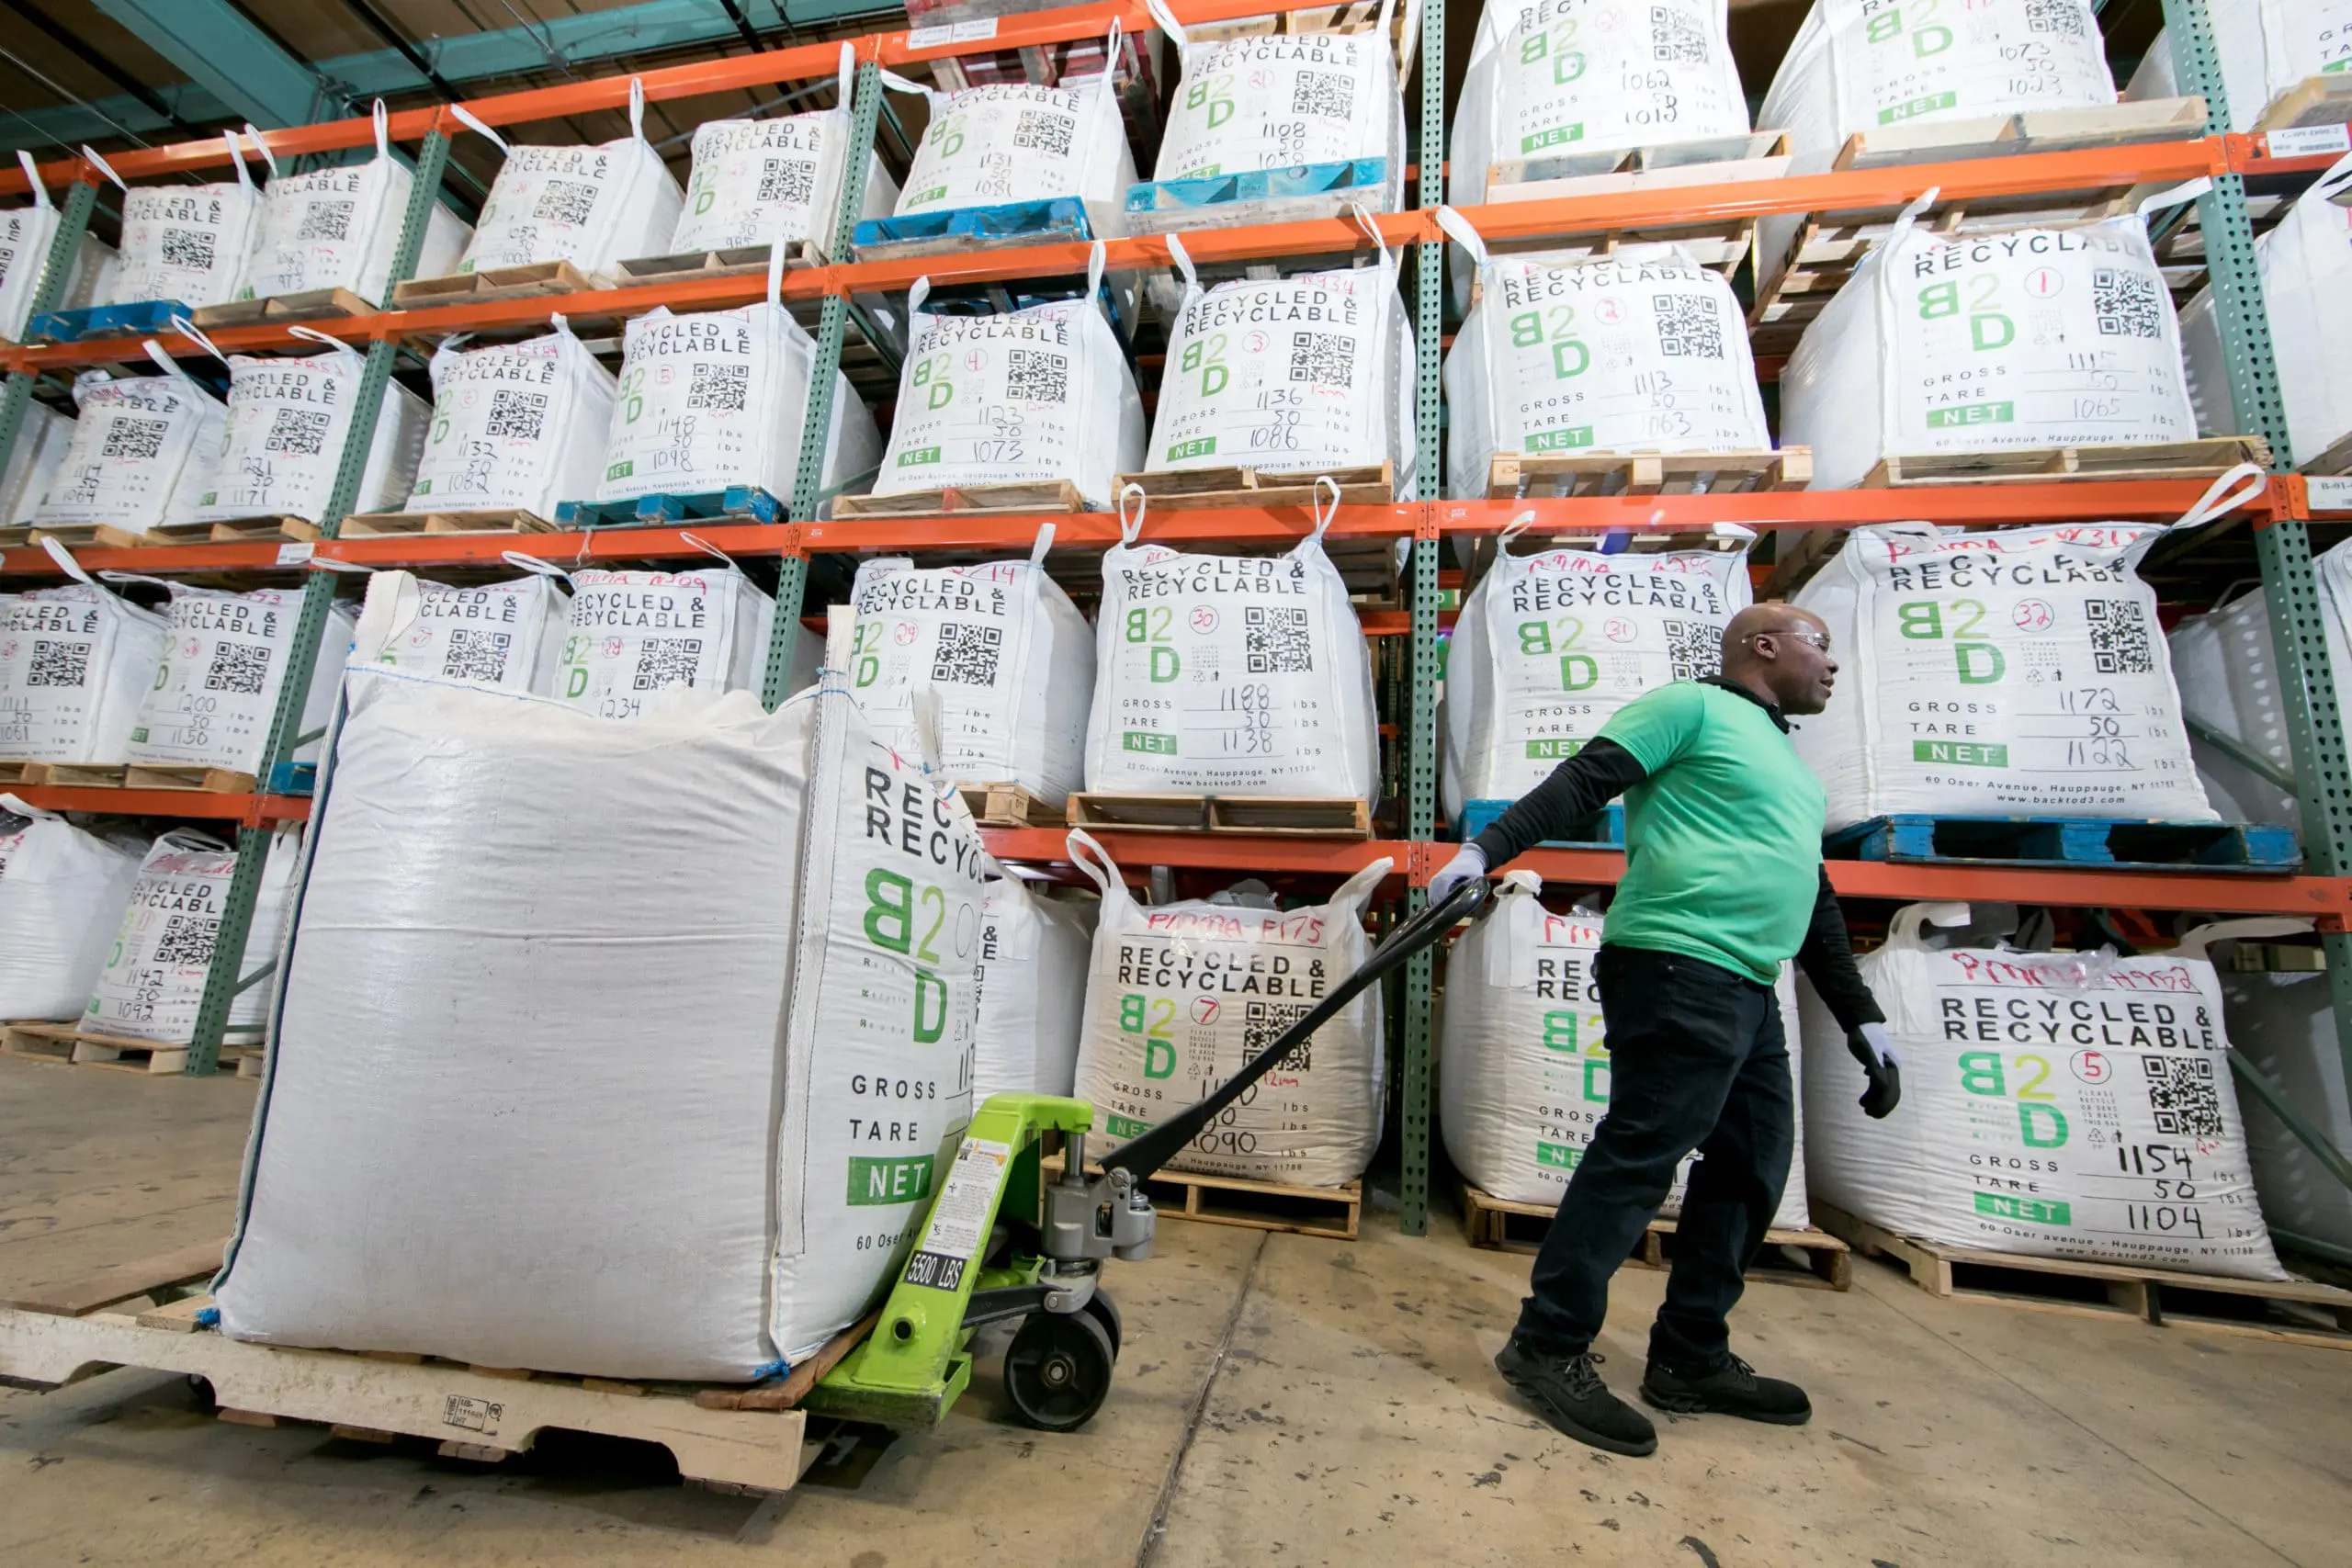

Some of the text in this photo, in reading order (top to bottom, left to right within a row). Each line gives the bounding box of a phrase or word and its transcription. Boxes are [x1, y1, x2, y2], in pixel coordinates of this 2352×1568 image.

[1912, 26, 1953, 58] D
[1554, 51, 1586, 85] D
[1208, 99, 1235, 130] D
[1520, 95, 1577, 118] GROSS
[1893, 95, 1944, 120] NET
[1263, 122, 1306, 138] 1108
[1521, 114, 1563, 131] TARE
[942, 133, 965, 158] D
[1280, 138, 1304, 150] 50
[1532, 126, 1575, 147] NET
[695, 191, 716, 216] D
[911, 187, 944, 204] NET
[1186, 290, 1328, 321] RECYCLED
[1184, 306, 1357, 338] RECYCLABLE
[1971, 313, 2016, 352] D
[918, 327, 1069, 355] RECYCLABLE
[1252, 334, 1263, 352] 3
[968, 351, 978, 371] 4
[1552, 340, 1589, 379] D
[1201, 366, 1228, 398] D
[1634, 369, 1673, 396] 1113
[1924, 365, 2007, 388] GROSS
[2086, 371, 2119, 391] 50
[929, 382, 953, 411] D
[1257, 388, 1302, 411] 1136
[1521, 392, 1585, 413] GROSS
[1925, 387, 1987, 406] TARE
[627, 396, 642, 424] D
[978, 406, 1024, 425] 1123
[1172, 407, 1216, 427] GROSS
[1273, 410, 1301, 426] 50
[1943, 405, 2004, 425] NET
[2073, 399, 2121, 420] 1065
[434, 420, 449, 445] D
[658, 415, 695, 434] 1148
[993, 424, 1023, 437] 50
[1522, 414, 1570, 430] TARE
[671, 435, 692, 448] 50
[1170, 427, 1202, 441] TARE
[1250, 425, 1298, 450] 1086
[1537, 429, 1585, 450] NET
[2124, 434, 2139, 442] NY
[904, 448, 934, 464] NET
[974, 440, 1023, 463] 1073
[1174, 440, 1208, 458] NET
[608, 463, 628, 479] NET
[1290, 562, 1305, 578] &
[1128, 577, 1307, 601] RECYCLABLE
[1512, 574, 1717, 598] RECYCLED &
[572, 592, 706, 612] ECYCLED &
[856, 596, 1005, 616] RECYCLABLE
[1514, 591, 1723, 615] RECYCLABLE
[1193, 609, 1214, 627] 30
[2018, 604, 2050, 626] 32
[1608, 620, 1628, 637] 31
[856, 657, 879, 688] D
[1150, 646, 1181, 682] D
[1559, 654, 1599, 692] D
[1955, 643, 2007, 684] D
[567, 669, 588, 699] D
[1123, 699, 1172, 710] GROSS
[1221, 683, 1270, 711] 1188
[1908, 701, 1997, 714] GROSS
[2060, 688, 2120, 714] 1172
[598, 699, 639, 719] 1234
[1246, 711, 1271, 728] 50
[1524, 705, 1591, 718] GROSS
[190, 716, 209, 729] 50
[1123, 717, 1159, 728] TARE
[1526, 724, 1575, 735] TARE
[1910, 723, 1976, 736] TARE
[2088, 716, 2120, 737] 50
[1132, 735, 1169, 752] NET
[1223, 730, 1272, 753] 1138
[1931, 744, 1995, 764] NET
[2067, 738, 2135, 769] 1122
[1164, 768, 1203, 777] Avenue,
[1926, 776, 2145, 794] 60 Oser Avenue, Hauppauge, NY
[1997, 794, 2126, 805] www.backtod3.com
[1120, 946, 1325, 977] RECYCLED &
[126, 970, 164, 986] 1142
[1118, 966, 1325, 998] RECYCLABLE
[135, 987, 159, 1001] 50
[913, 966, 948, 1043] D
[118, 1002, 154, 1021] 1092
[1199, 999, 1218, 1022] 7
[1941, 998, 2211, 1026] RECYCLED &
[1944, 1020, 2214, 1051] RECYCLABLE
[1145, 1039, 1177, 1080] D
[2084, 1052, 2102, 1077] 5
[852, 1075, 936, 1100] GROSS
[1114, 1082, 1162, 1100] GROSS
[1112, 1100, 1147, 1117] TARE
[849, 1119, 918, 1141] TARE
[1539, 1125, 1590, 1144] TARE
[2018, 1101, 2069, 1149] D
[1970, 1154, 2059, 1173] GROSS
[2118, 1145, 2192, 1180] 1154
[869, 1163, 926, 1199] NET
[1538, 1171, 1550, 1179] 60
[1973, 1175, 2041, 1193] TARE
[2154, 1181, 2196, 1200] 50
[1994, 1198, 2056, 1221] NET
[2129, 1203, 2204, 1239] 1104
[856, 1233, 905, 1250] 60 Oser
[1980, 1223, 1996, 1232] 60
[2003, 1225, 2037, 1238] Oser
[2043, 1234, 2094, 1246] avenue
[2112, 1240, 2196, 1255] Hauppauge,
[2200, 1247, 2218, 1255] NY
[908, 1254, 963, 1289] 5500 LBS
